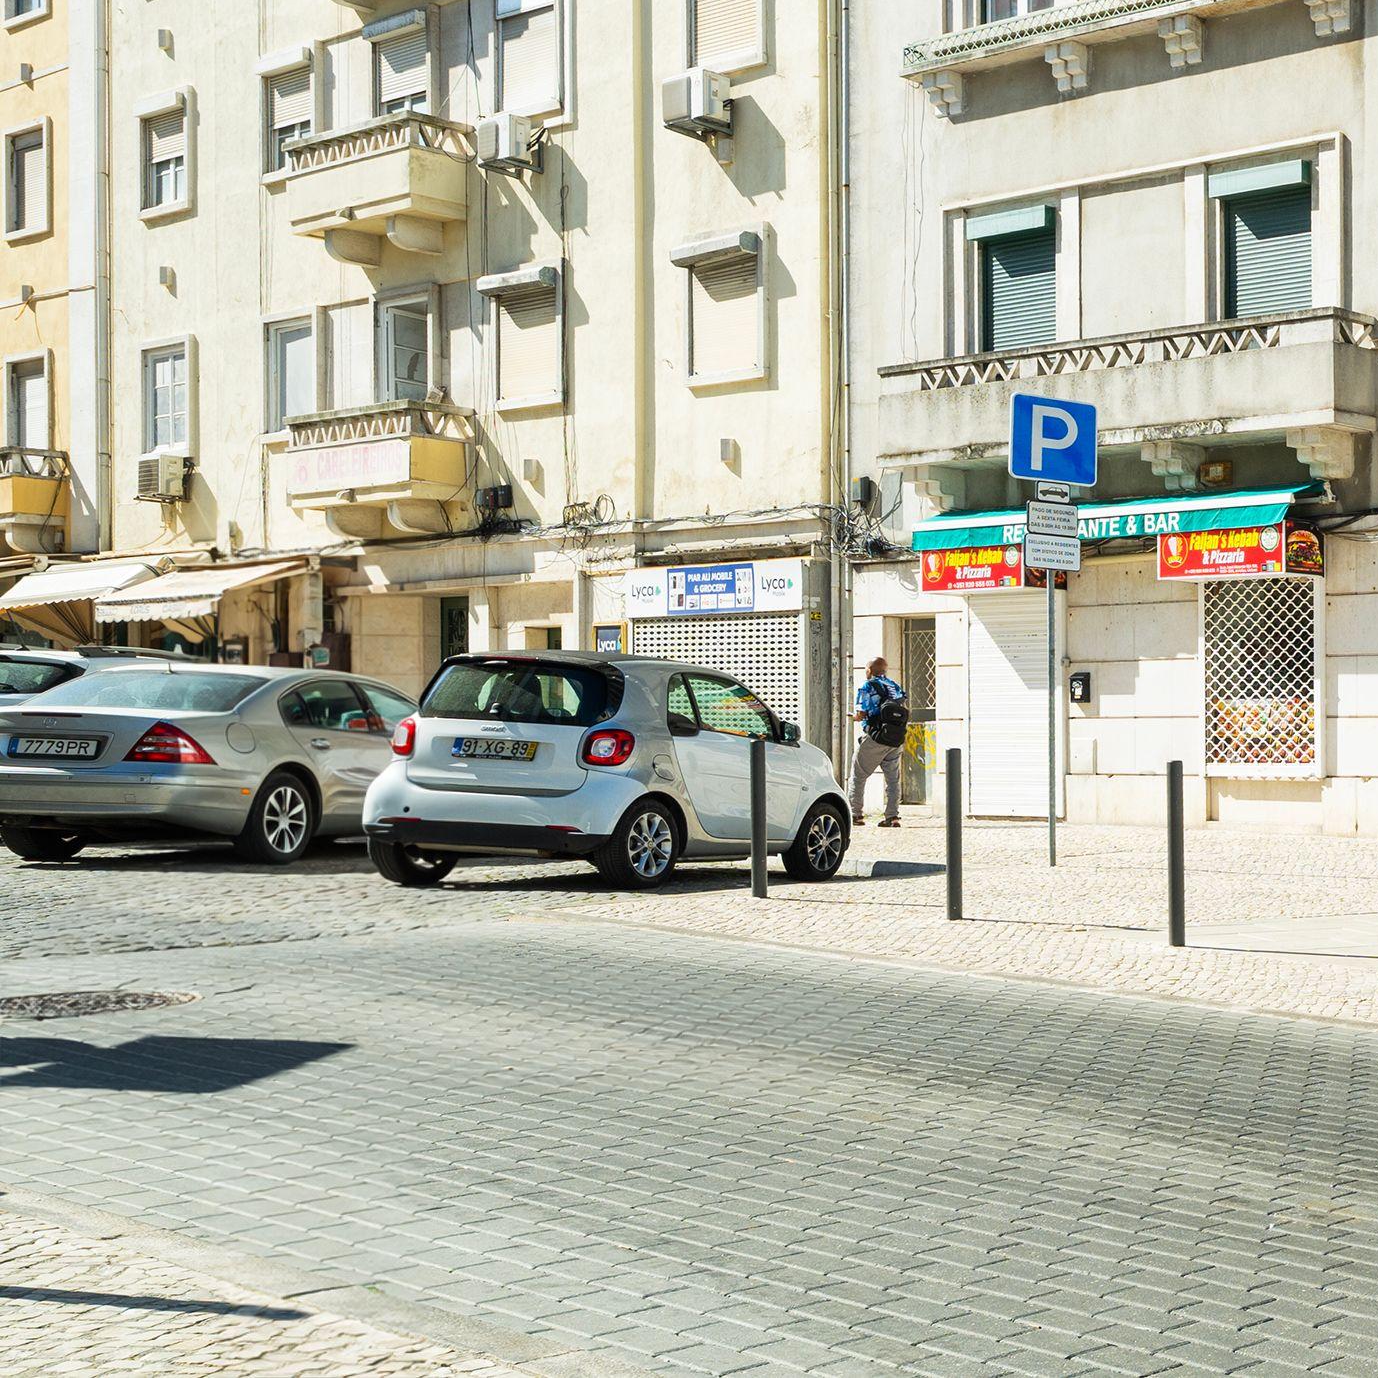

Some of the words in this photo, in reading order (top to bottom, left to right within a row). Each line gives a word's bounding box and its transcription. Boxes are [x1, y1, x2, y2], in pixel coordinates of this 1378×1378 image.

[1030, 404, 1079, 472] P
[1003, 516, 1121, 544] REANTE
[1125, 515, 1138, 535] &
[1143, 512, 1181, 533] BAR
[1228, 528, 1259, 548] Kebab
[977, 546, 1003, 565] Kebab
[1202, 552, 1210, 565] &
[1210, 549, 1245, 564] Pizzaria
[711, 571, 733, 581] MOBILE
[962, 565, 992, 579] Pizzaria
[699, 583, 727, 593] GROCERY
[761, 576, 786, 591] Lyca
[631, 584, 654, 600] Lyca
[596, 638, 616, 652] Lyca
[24, 739, 90, 755] 7779PR
